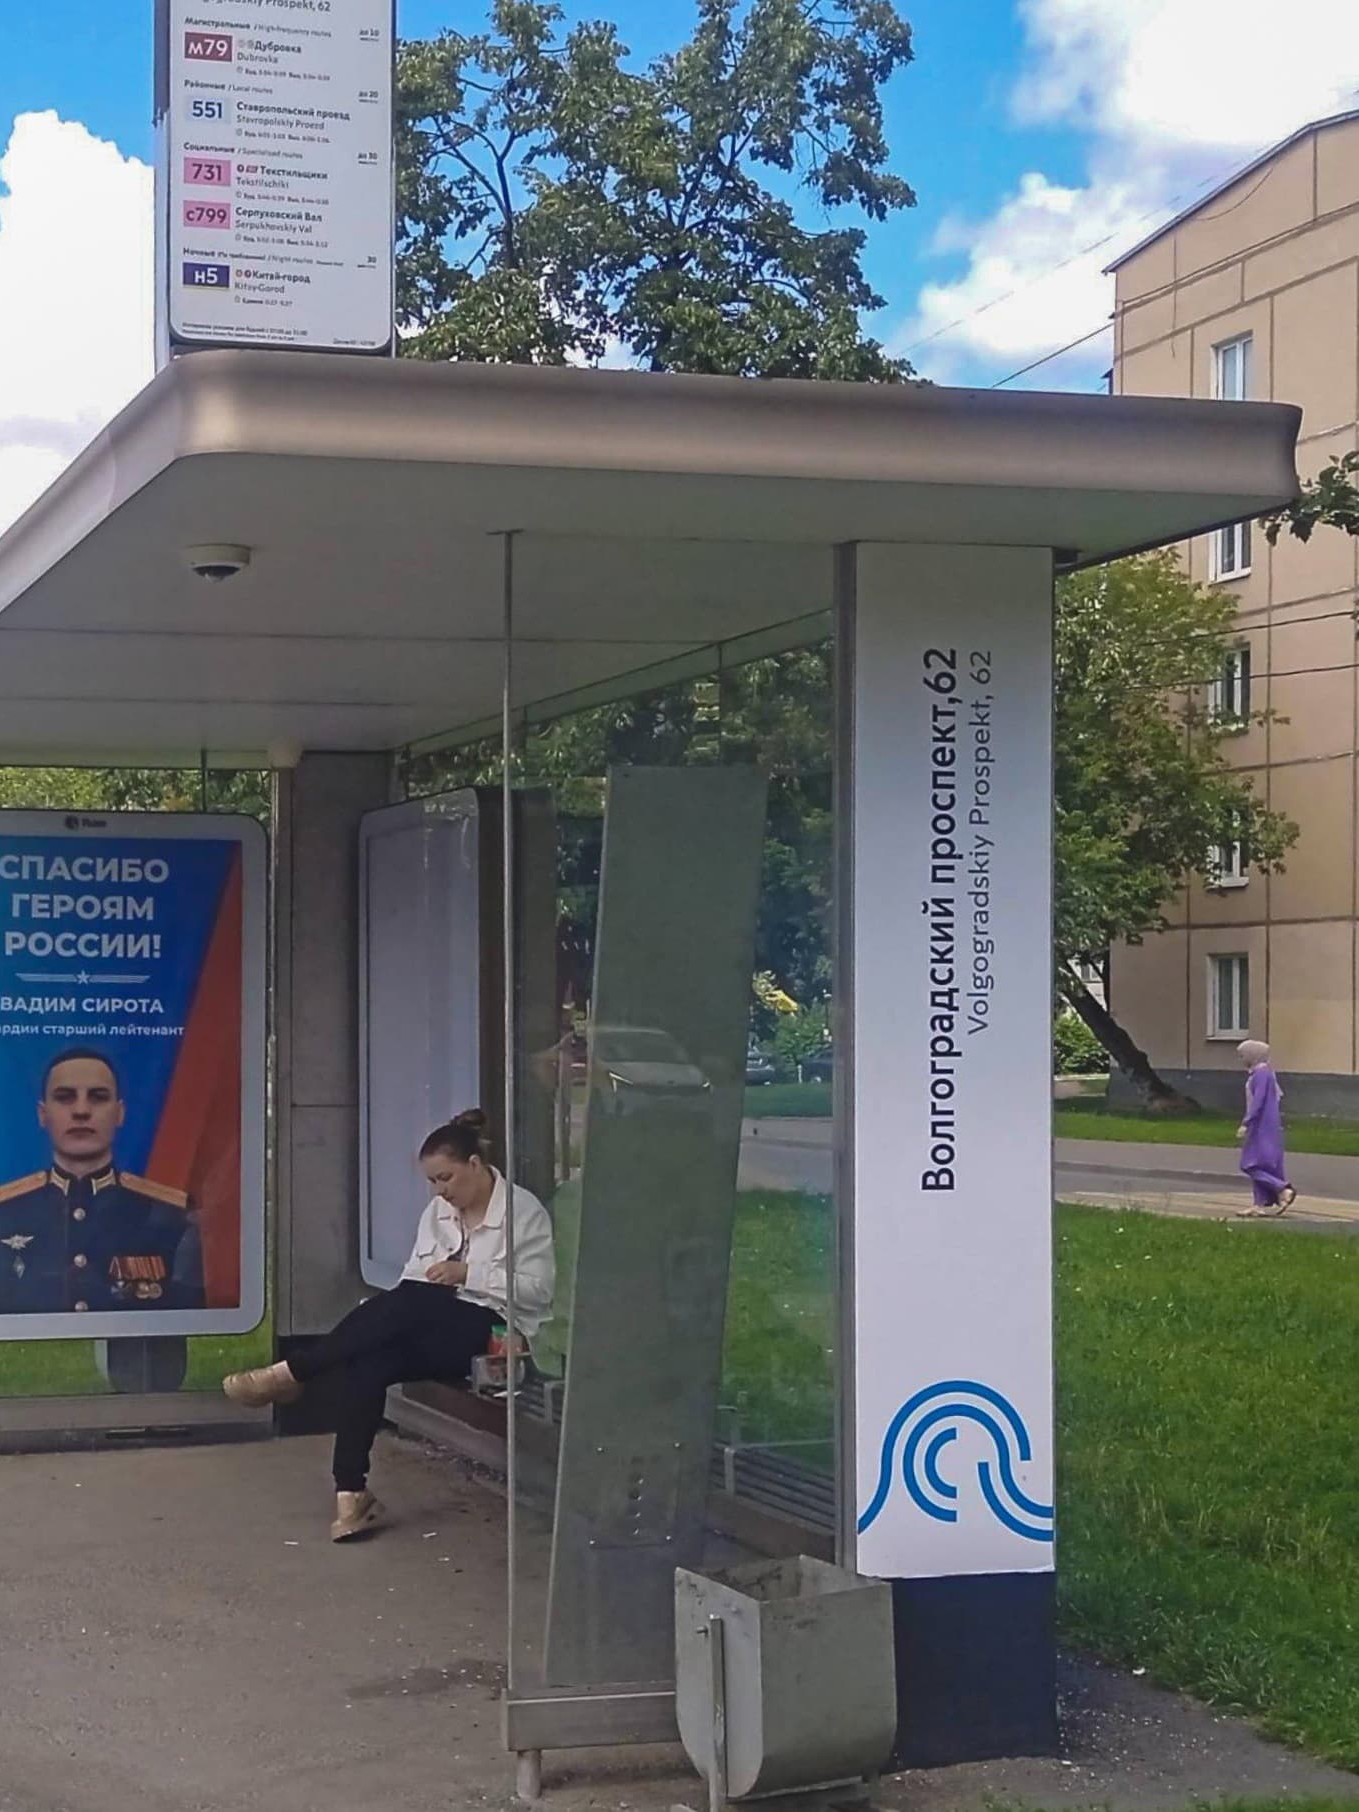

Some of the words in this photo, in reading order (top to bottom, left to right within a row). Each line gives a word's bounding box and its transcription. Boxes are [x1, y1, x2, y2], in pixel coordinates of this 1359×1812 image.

[318, 1, 331, 12] 62
[255, 42, 302, 54] Дубровка
[237, 52, 278, 64] Dubrovka
[192, 100, 223, 119] 551
[236, 101, 315, 117] Ставропольский
[316, 108, 351, 121] проезд
[295, 117, 324, 130] Proezd
[192, 163, 223, 182] 731
[260, 166, 328, 180] Текстильщики
[236, 206, 304, 222] Серпуховский
[304, 212, 322, 222] Вал
[298, 222, 312, 234] Val
[252, 268, 311, 284] Китай-город
[969, 650, 991, 684] 62
[968, 694, 994, 826] Prospekt,
[10, 894, 154, 921] ГЕРОЯМ
[968, 834, 995, 1036] Volgogradskiy
[4, 931, 162, 959] РОССИИ!
[0, 996, 76, 1016] ВАДИМ
[82, 997, 164, 1014] СИРОТА
[42, 1022, 106, 1038] старший
[108, 1022, 185, 1037] лейтенант
[922, 897, 963, 1192] Волгоградский
